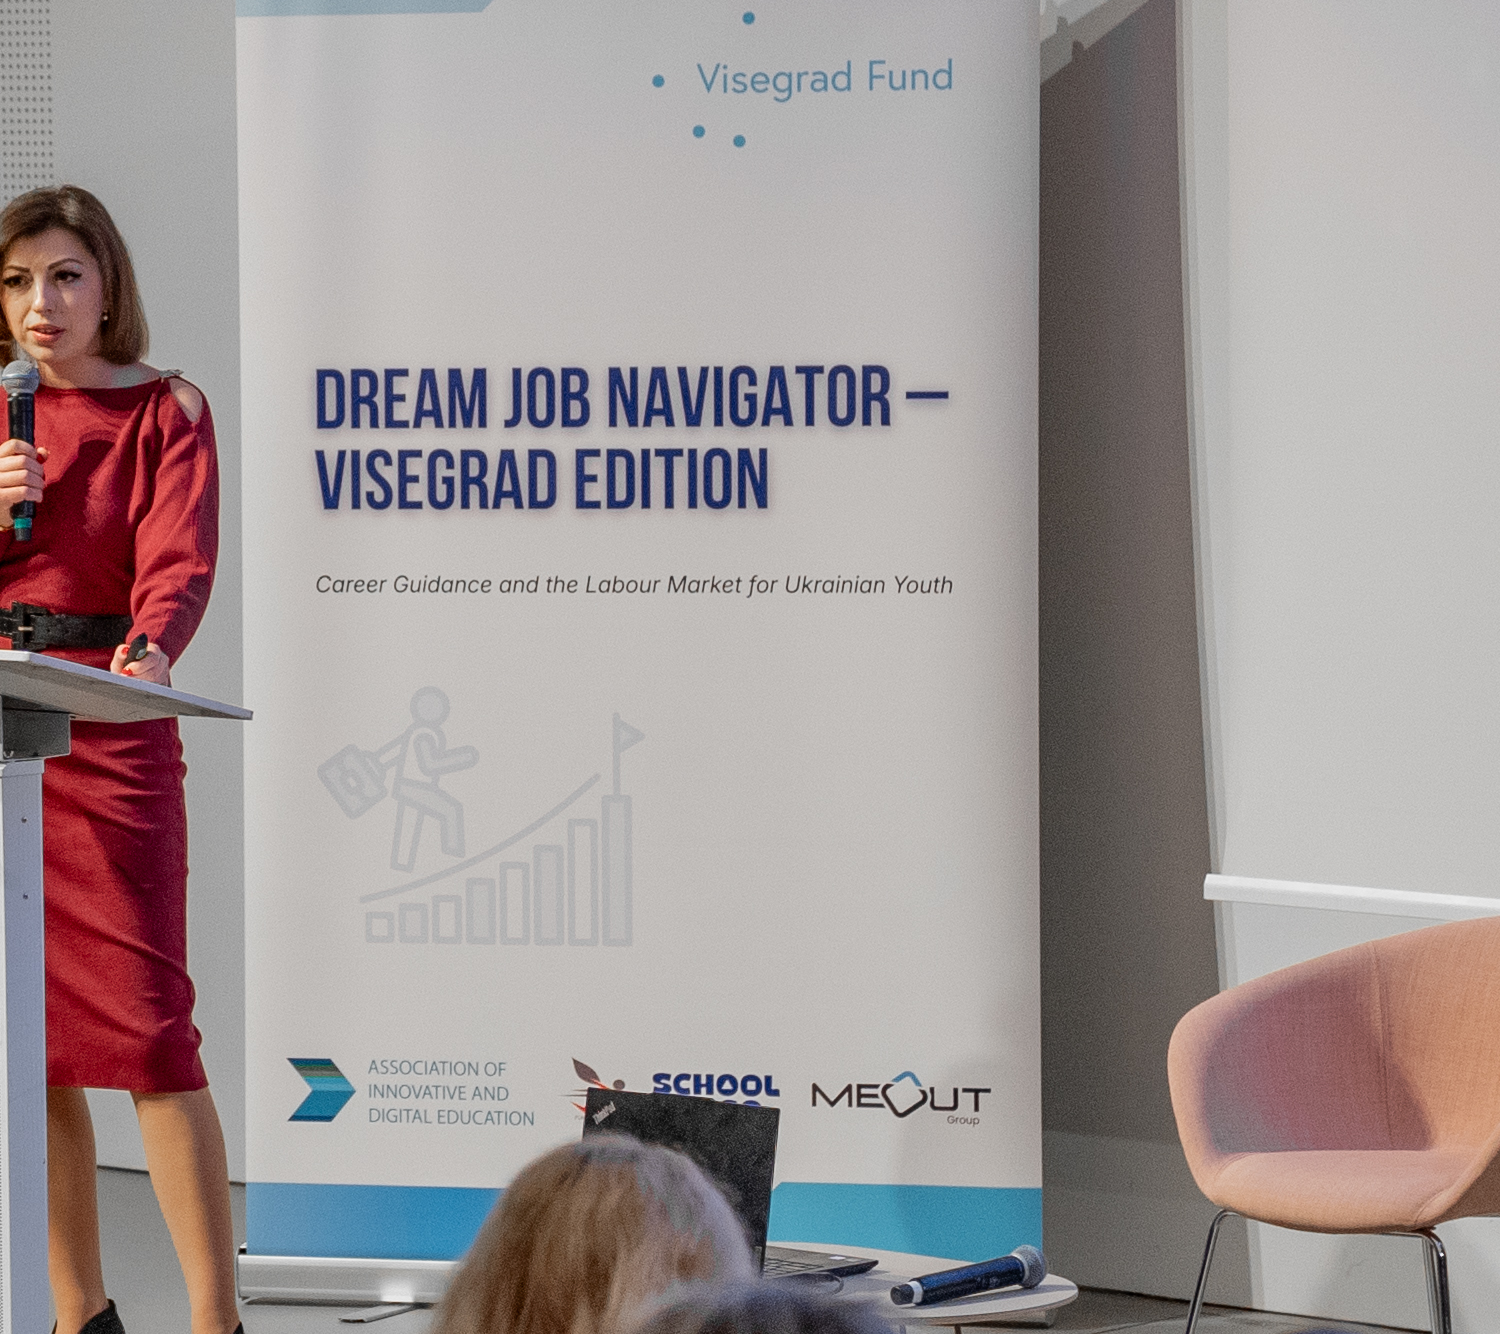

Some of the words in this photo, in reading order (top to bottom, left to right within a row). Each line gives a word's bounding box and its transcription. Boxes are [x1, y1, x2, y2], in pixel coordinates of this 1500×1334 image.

[696, 59, 852, 103] Visegrad
[868, 58, 953, 91] Fund
[315, 367, 488, 429] DREAM
[504, 366, 591, 429] JOB
[607, 365, 892, 428] NAVIGATOR
[315, 449, 557, 510] VISEGRAD
[575, 448, 769, 510] EDITION
[315, 574, 387, 594] Career
[393, 574, 492, 594] Guidance
[499, 575, 539, 594] and
[546, 575, 578, 594] the
[585, 574, 661, 594] Labour
[667, 574, 742, 594] Market
[746, 574, 779, 599] for
[784, 574, 886, 595] Ukrainian
[894, 575, 954, 595] Youth
[367, 1059, 480, 1077] ASSOCIATION
[484, 1061, 507, 1077] OF
[367, 1083, 467, 1101] INNOVATIVE
[471, 1086, 510, 1101] AND
[652, 1072, 781, 1098] SCHOOL
[811, 1070, 992, 1119] MEOUT
[368, 1108, 433, 1125] DIGITAL
[437, 1109, 536, 1126] EDUCATION
[946, 1115, 981, 1127] Group
